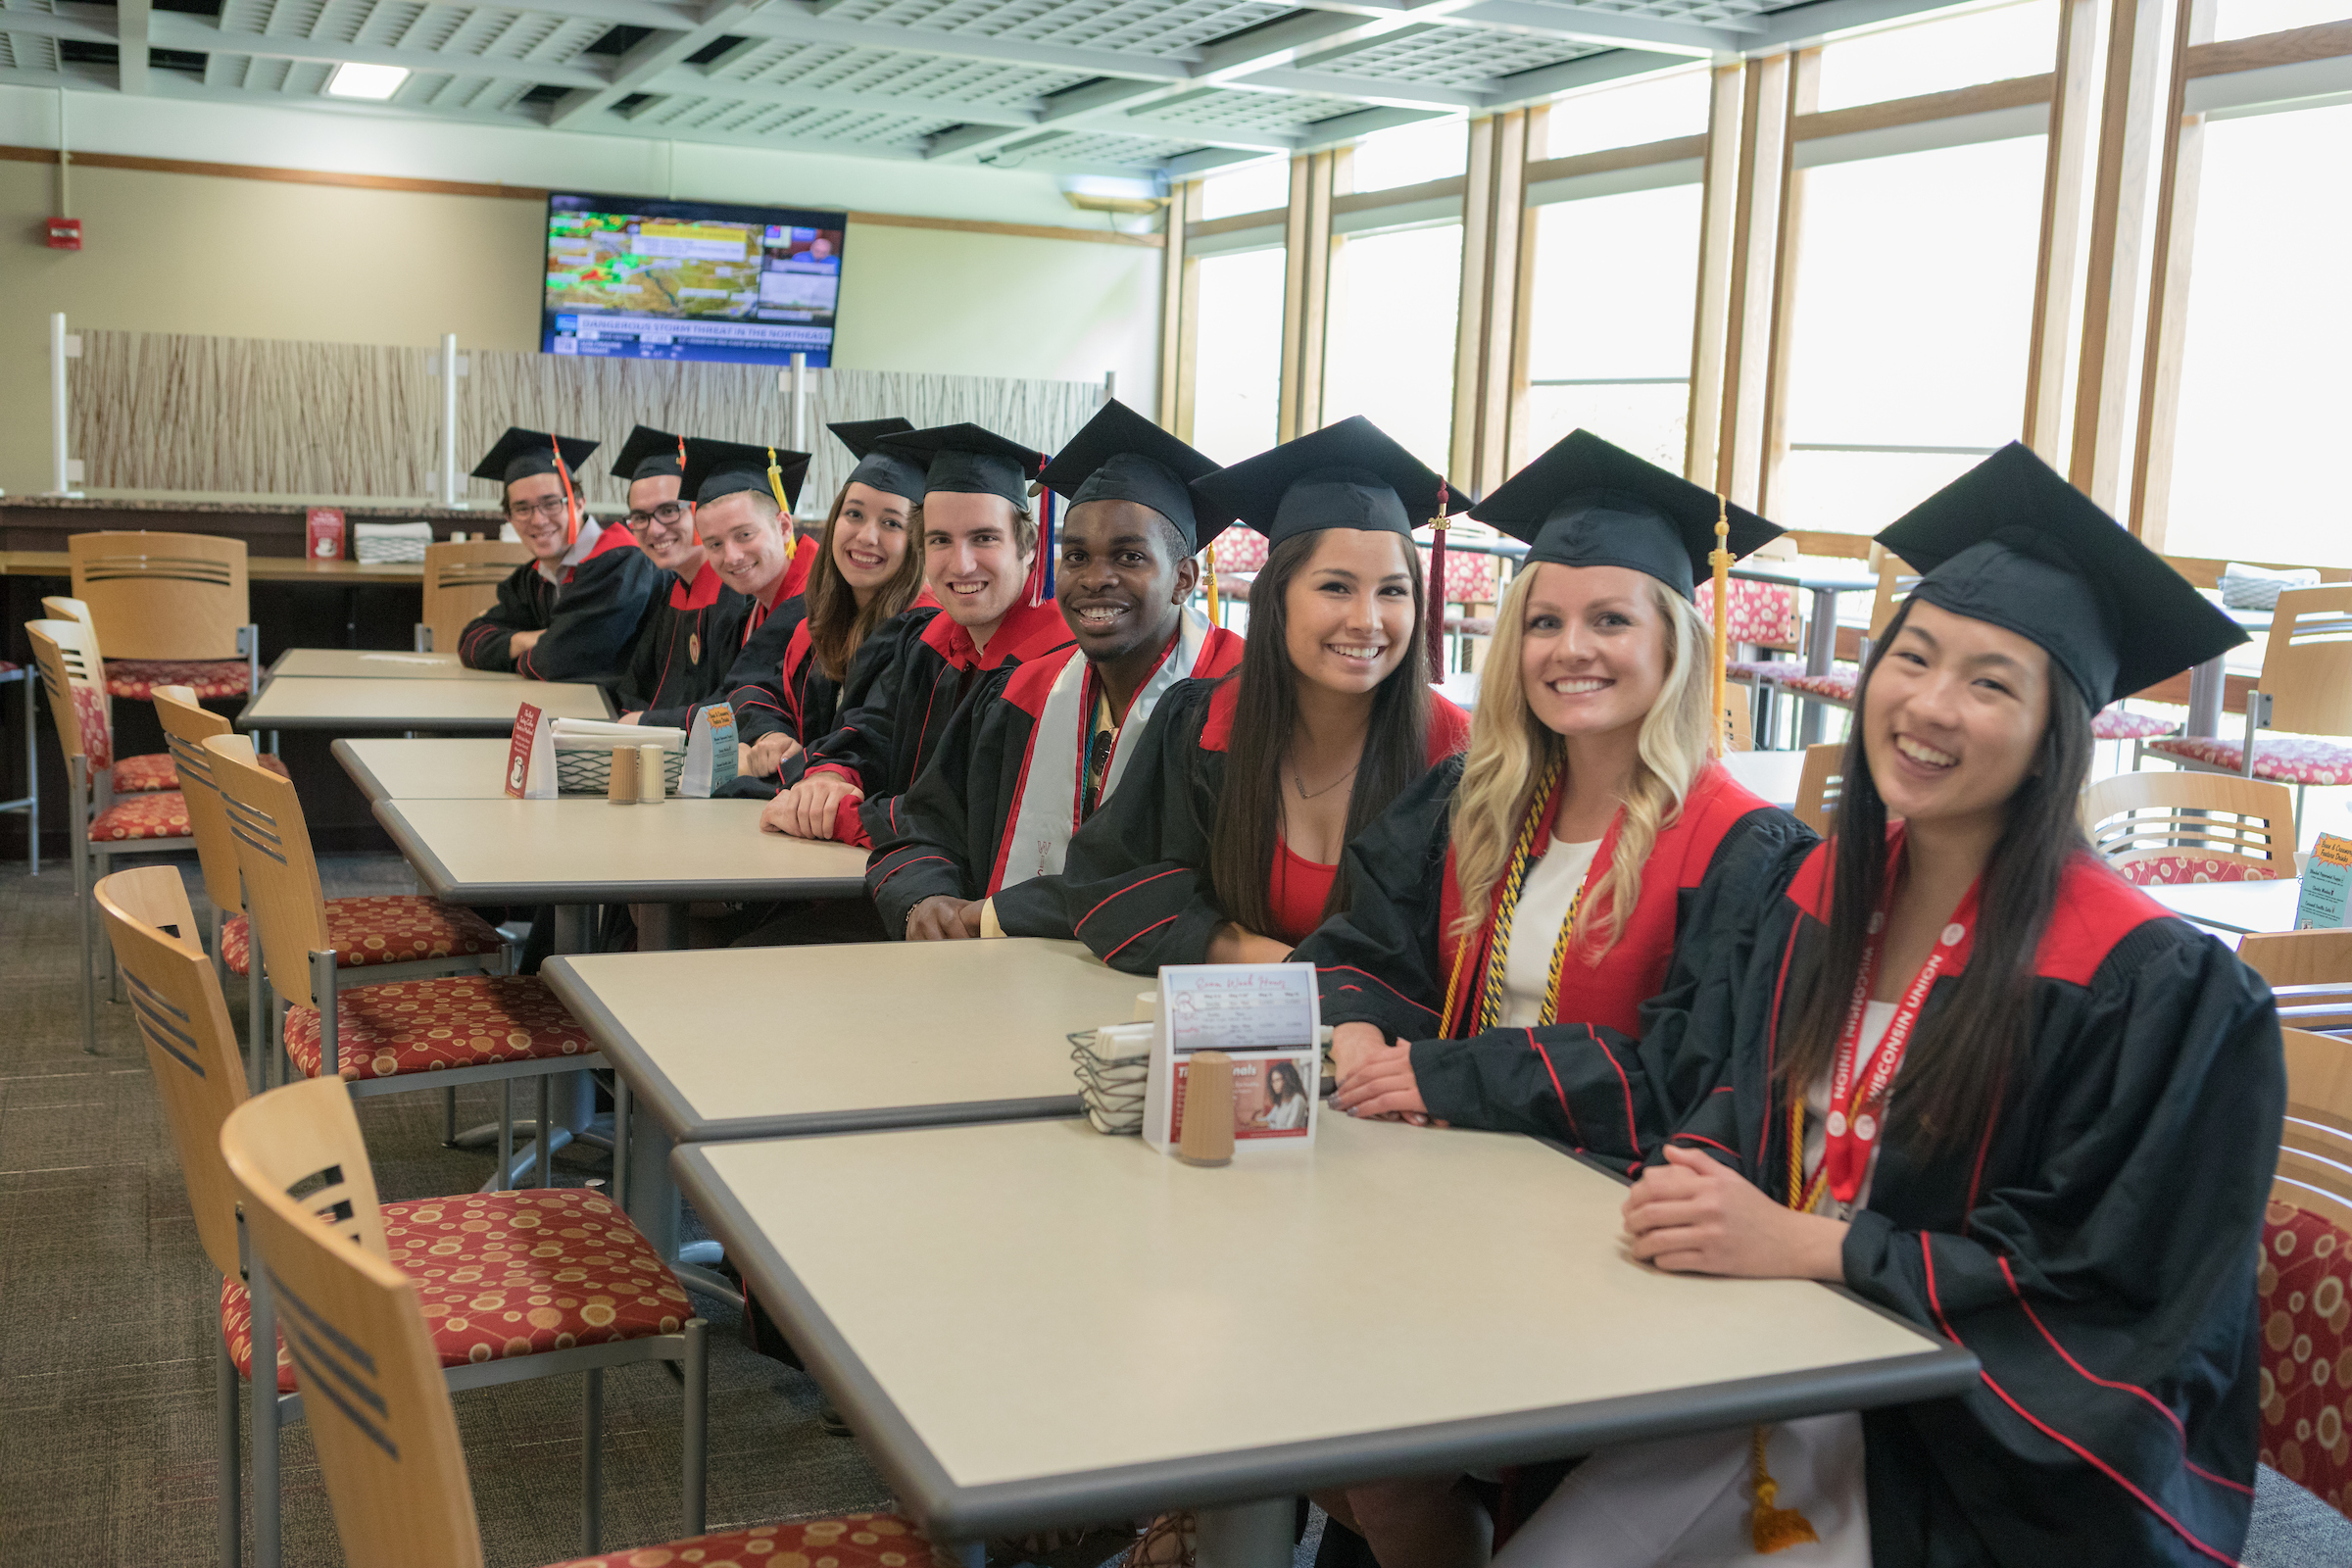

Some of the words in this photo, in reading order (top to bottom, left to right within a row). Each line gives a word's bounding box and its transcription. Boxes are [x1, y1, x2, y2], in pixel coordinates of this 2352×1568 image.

[582, 319, 653, 331] DANGEROUS
[655, 322, 690, 332] STORM
[693, 325, 731, 335] THREAT
[749, 328, 766, 337] THE
[768, 329, 829, 340] NORTHEAST
[2334, 853, 2348, 862] Drinks
[1868, 1010, 1914, 1102] WISCONSIN
[1905, 954, 1943, 1008] UNION
[1232, 1063, 1256, 1077] nals
